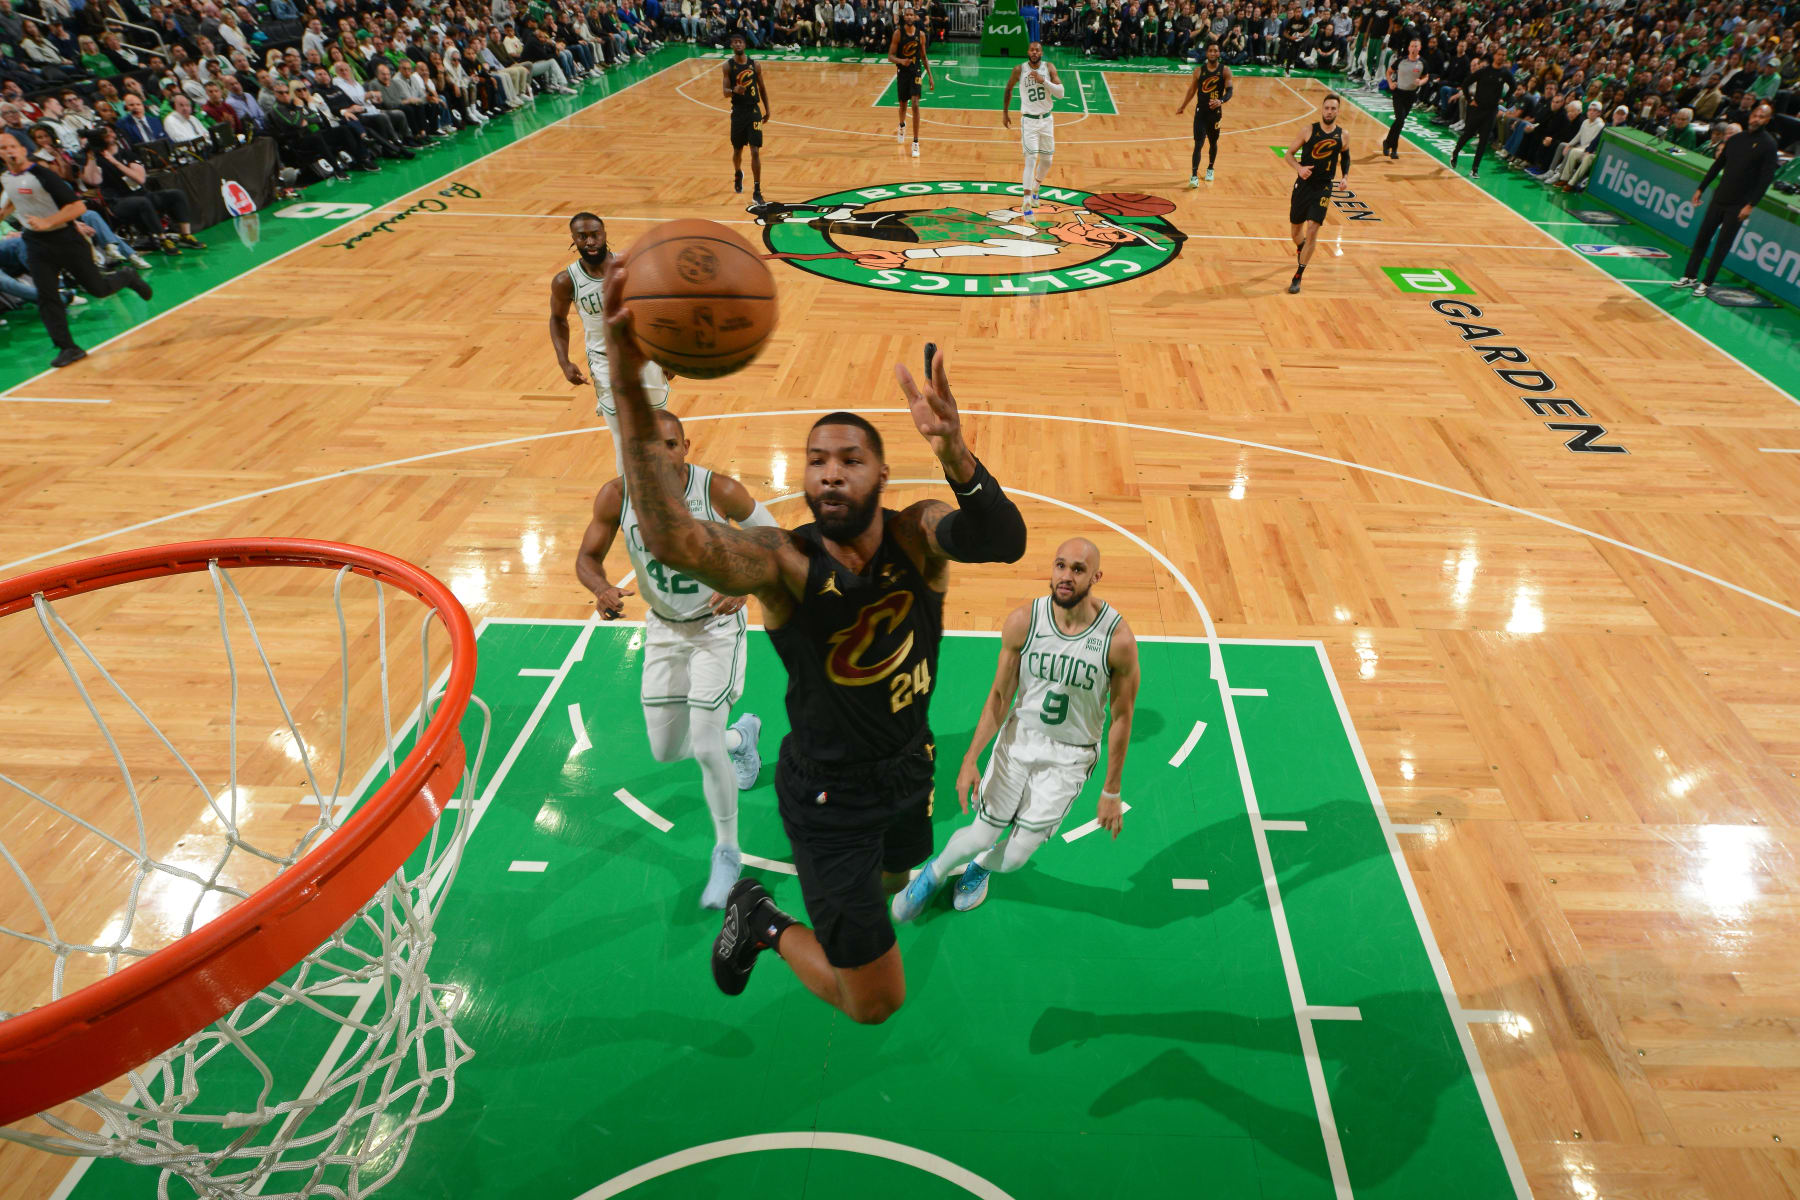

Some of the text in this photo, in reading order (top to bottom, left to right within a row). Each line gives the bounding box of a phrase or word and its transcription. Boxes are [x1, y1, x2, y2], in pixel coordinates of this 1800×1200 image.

[989, 25, 1022, 34] KIA
[841, 57, 959, 67] CELCS
[750, 86, 756, 97] 3
[1028, 86, 1046, 102] 26
[856, 182, 1080, 202] BOSTON
[1598, 154, 1696, 229] Hisense
[1730, 217, 1800, 289] isen
[868, 259, 1142, 294] CELTICS
[1400, 270, 1632, 455] TD GARDEN
[646, 559, 699, 594] 42
[890, 658, 931, 714] 24
[1028, 652, 1098, 691] CELTICS
[1040, 690, 1070, 725] 9
